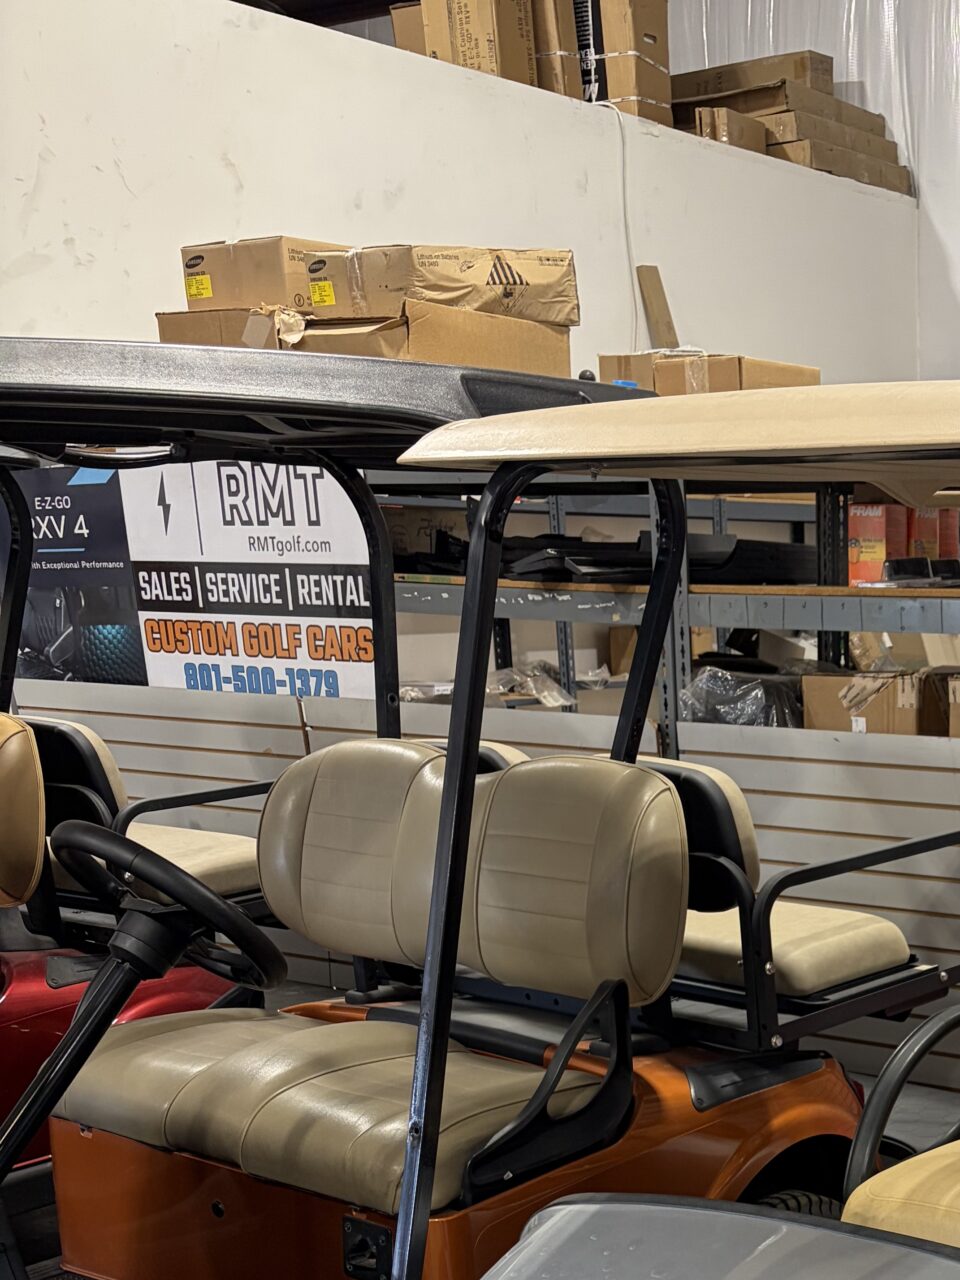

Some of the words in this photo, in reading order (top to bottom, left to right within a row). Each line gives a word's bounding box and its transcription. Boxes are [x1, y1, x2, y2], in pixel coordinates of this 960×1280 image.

[34, 495, 71, 510] E-Z-GO
[216, 461, 326, 527] RMT
[849, 505, 882, 518] FRAM
[73, 513, 90, 538] 4
[248, 535, 332, 557] RMTgolf.com
[42, 561, 80, 571] Exceptional
[81, 560, 124, 569] Performance
[138, 571, 193, 602] SALES
[205, 572, 283, 605] SERVICE
[144, 618, 240, 657] CUSTOM
[241, 621, 303, 660] GOLF
[305, 624, 376, 663] CARS
[183, 662, 340, 699] 801-500-1379
